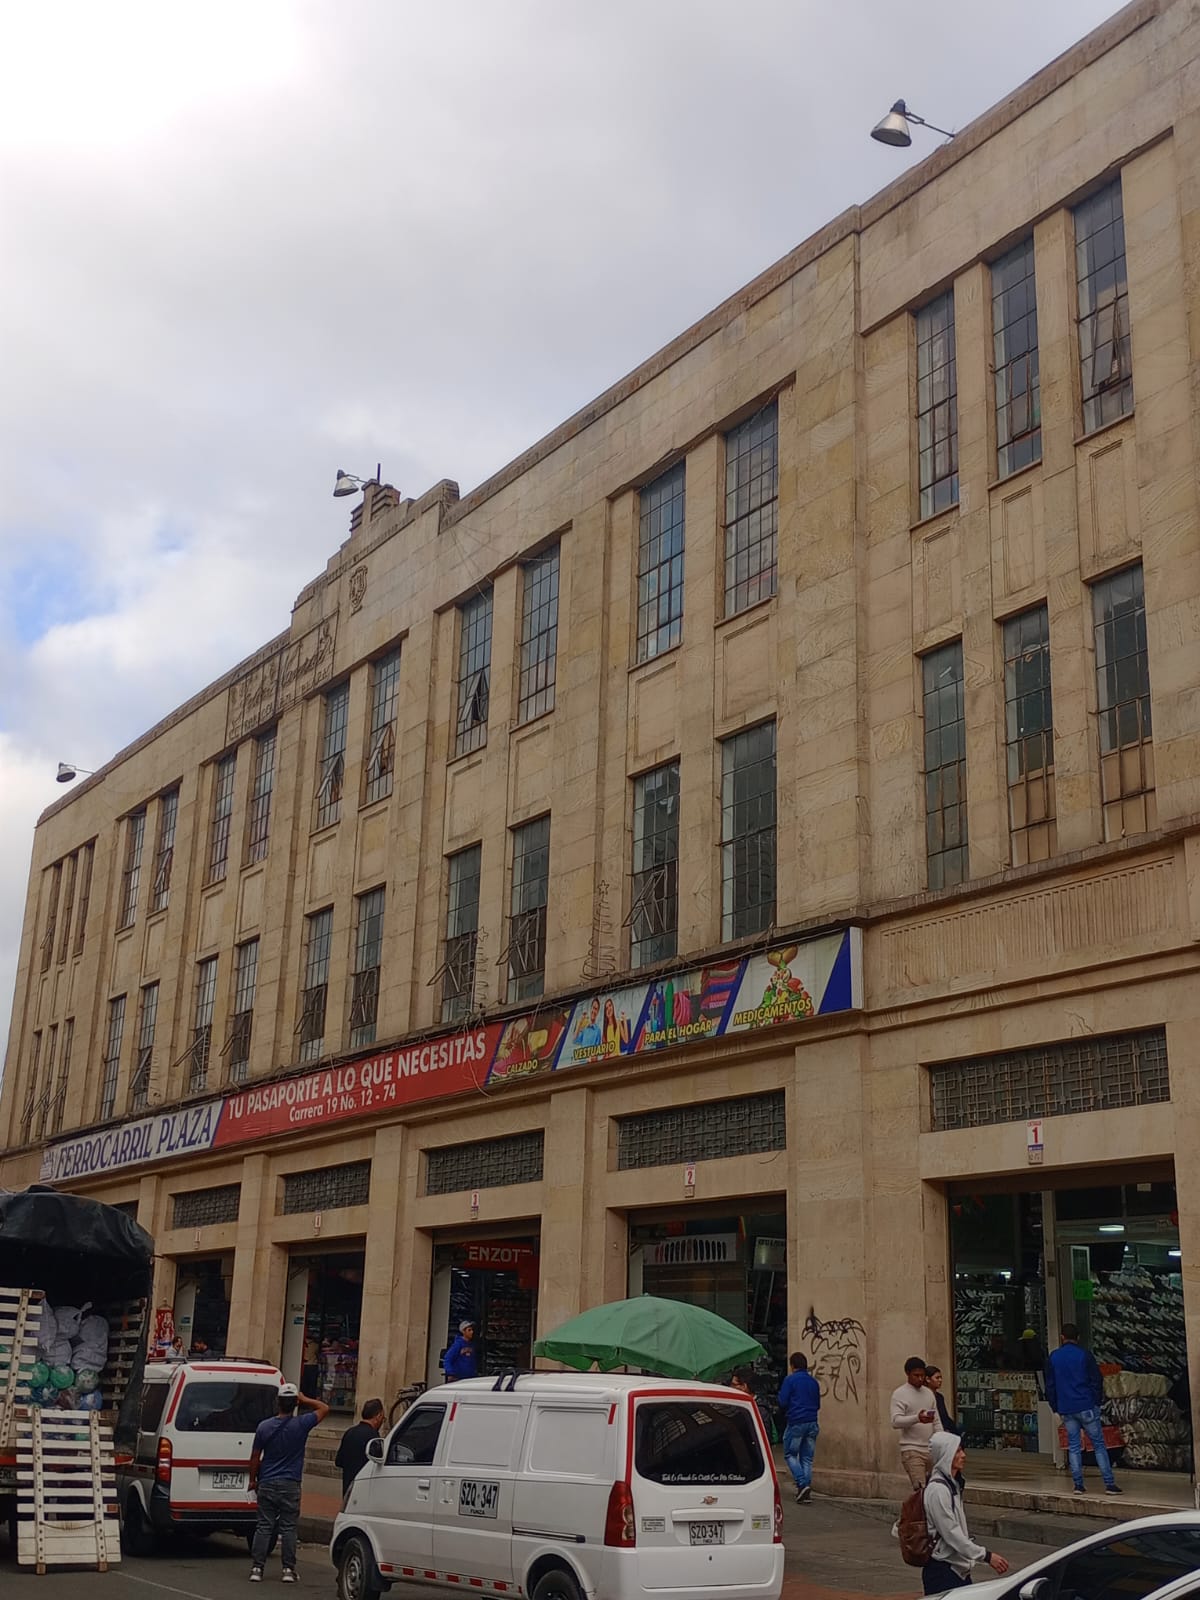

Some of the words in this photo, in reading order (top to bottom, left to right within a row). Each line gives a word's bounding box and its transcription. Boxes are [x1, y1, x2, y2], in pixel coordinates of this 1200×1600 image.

[733, 998, 812, 1026] MEDICAMENTOS
[643, 1030, 666, 1045] PARA
[667, 1029, 677, 1040] EL
[679, 1020, 713, 1036] HOGAR
[572, 1041, 616, 1061] VESTUARIO
[229, 1095, 244, 1120] TU
[247, 1076, 320, 1115] PASAPORTE
[322, 1073, 333, 1097] A
[337, 1067, 356, 1093] LO
[360, 1057, 393, 1089] QUE
[397, 1032, 486, 1079] NECESITAS
[506, 1058, 539, 1075] CALZADO
[289, 1103, 323, 1122] Carrera
[327, 1097, 338, 1114] 19
[340, 1094, 357, 1111] No.
[361, 1088, 373, 1106] 12
[383, 1083, 396, 1101] 74
[54, 1121, 154, 1179] FERROCARRIL
[155, 1105, 212, 1155] PLAZA
[1031, 1126, 1039, 1144] 1
[687, 1170, 693, 1185] 2
